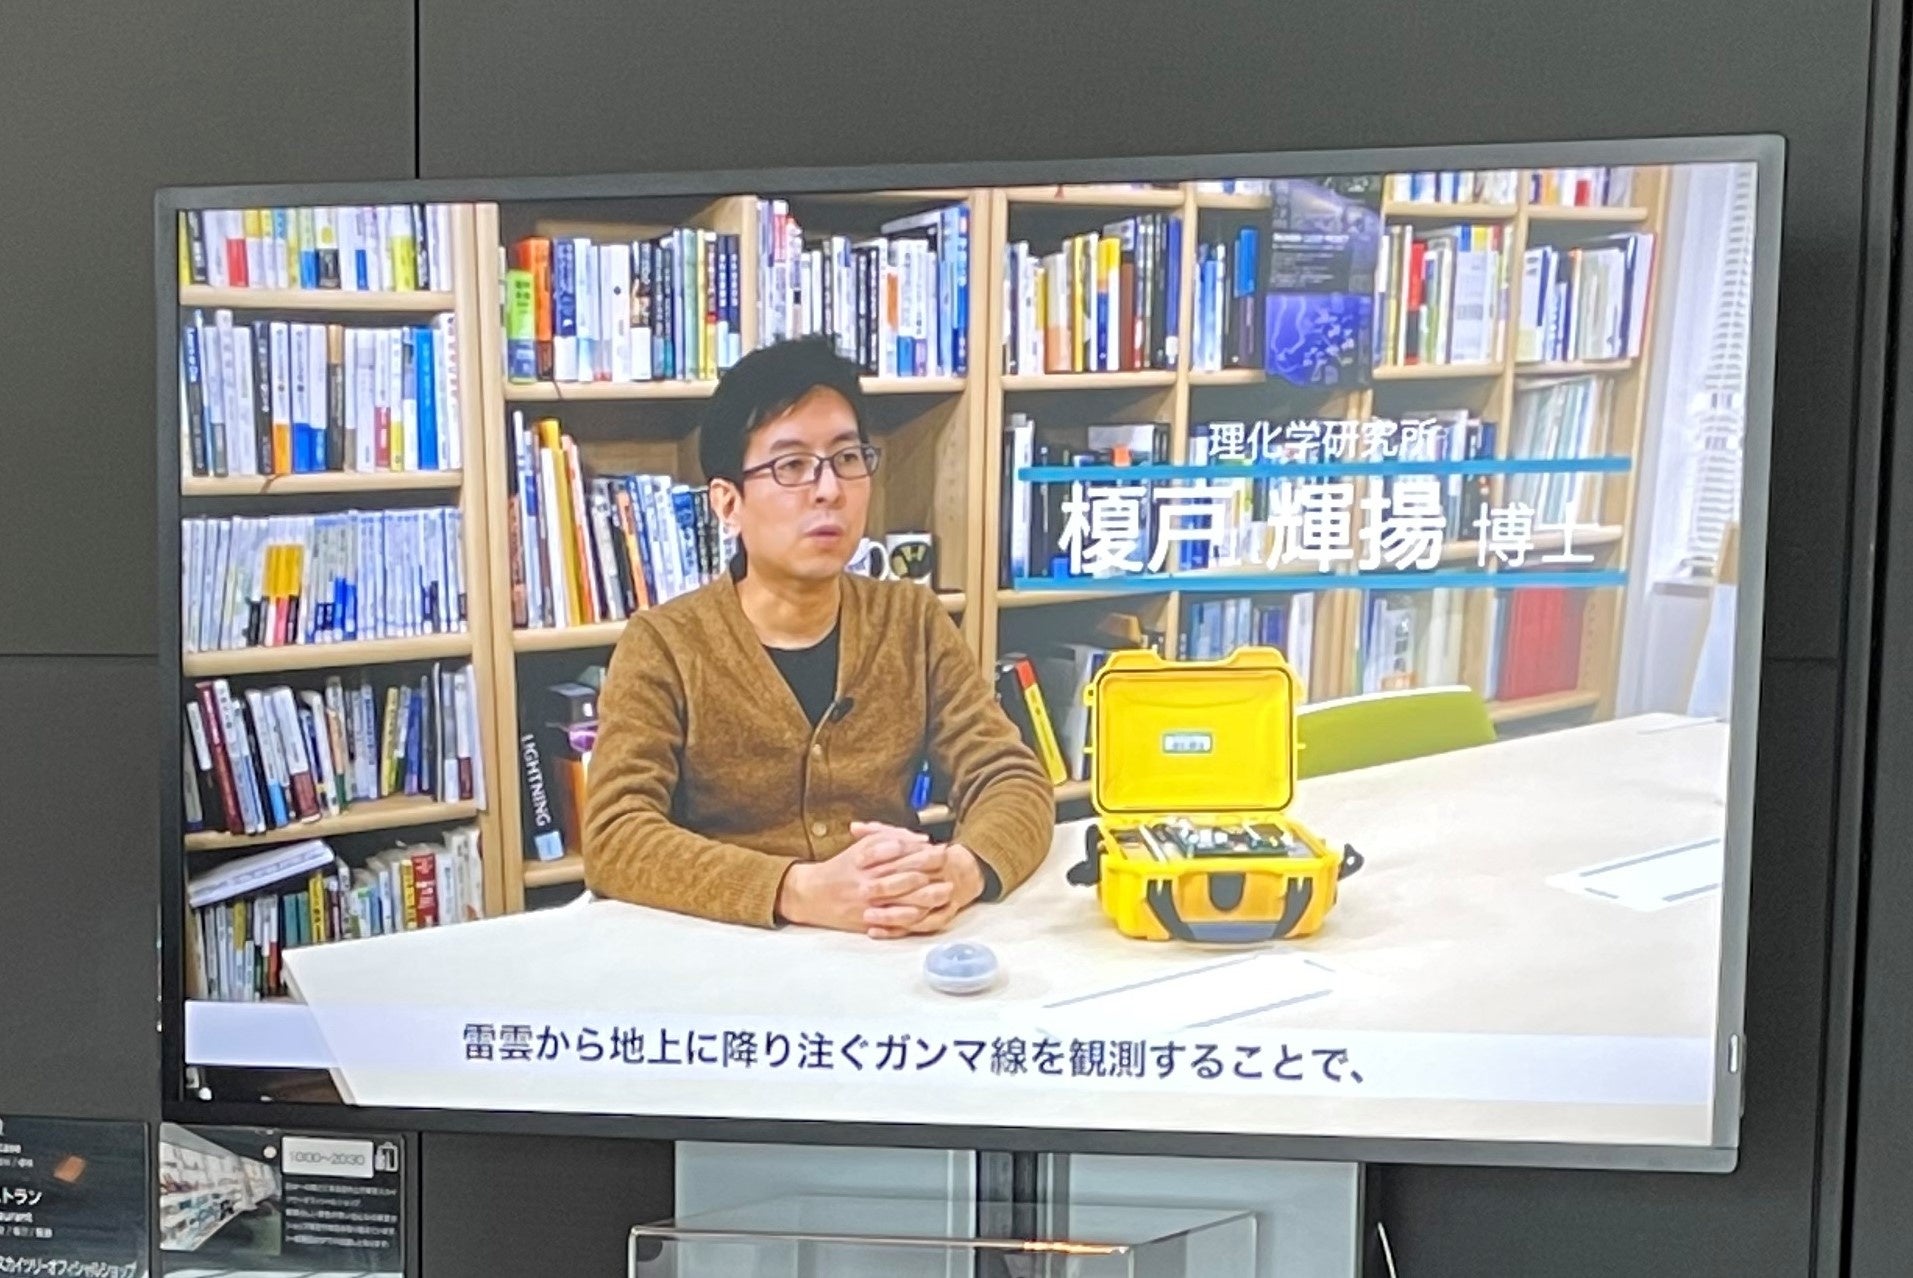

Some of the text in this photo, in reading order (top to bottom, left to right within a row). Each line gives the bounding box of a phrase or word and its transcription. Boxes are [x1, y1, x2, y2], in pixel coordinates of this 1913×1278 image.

[1208, 417, 1440, 464] 理化学研究所
[1058, 479, 1595, 576] 榎戸 輝揚 博士
[521, 733, 552, 827] LIGHTNING
[463, 1022, 1364, 1084] 雷雲から地上に降り注ぐガンマ線を観測することで、
[0, 1187, 43, 1205] トラン
